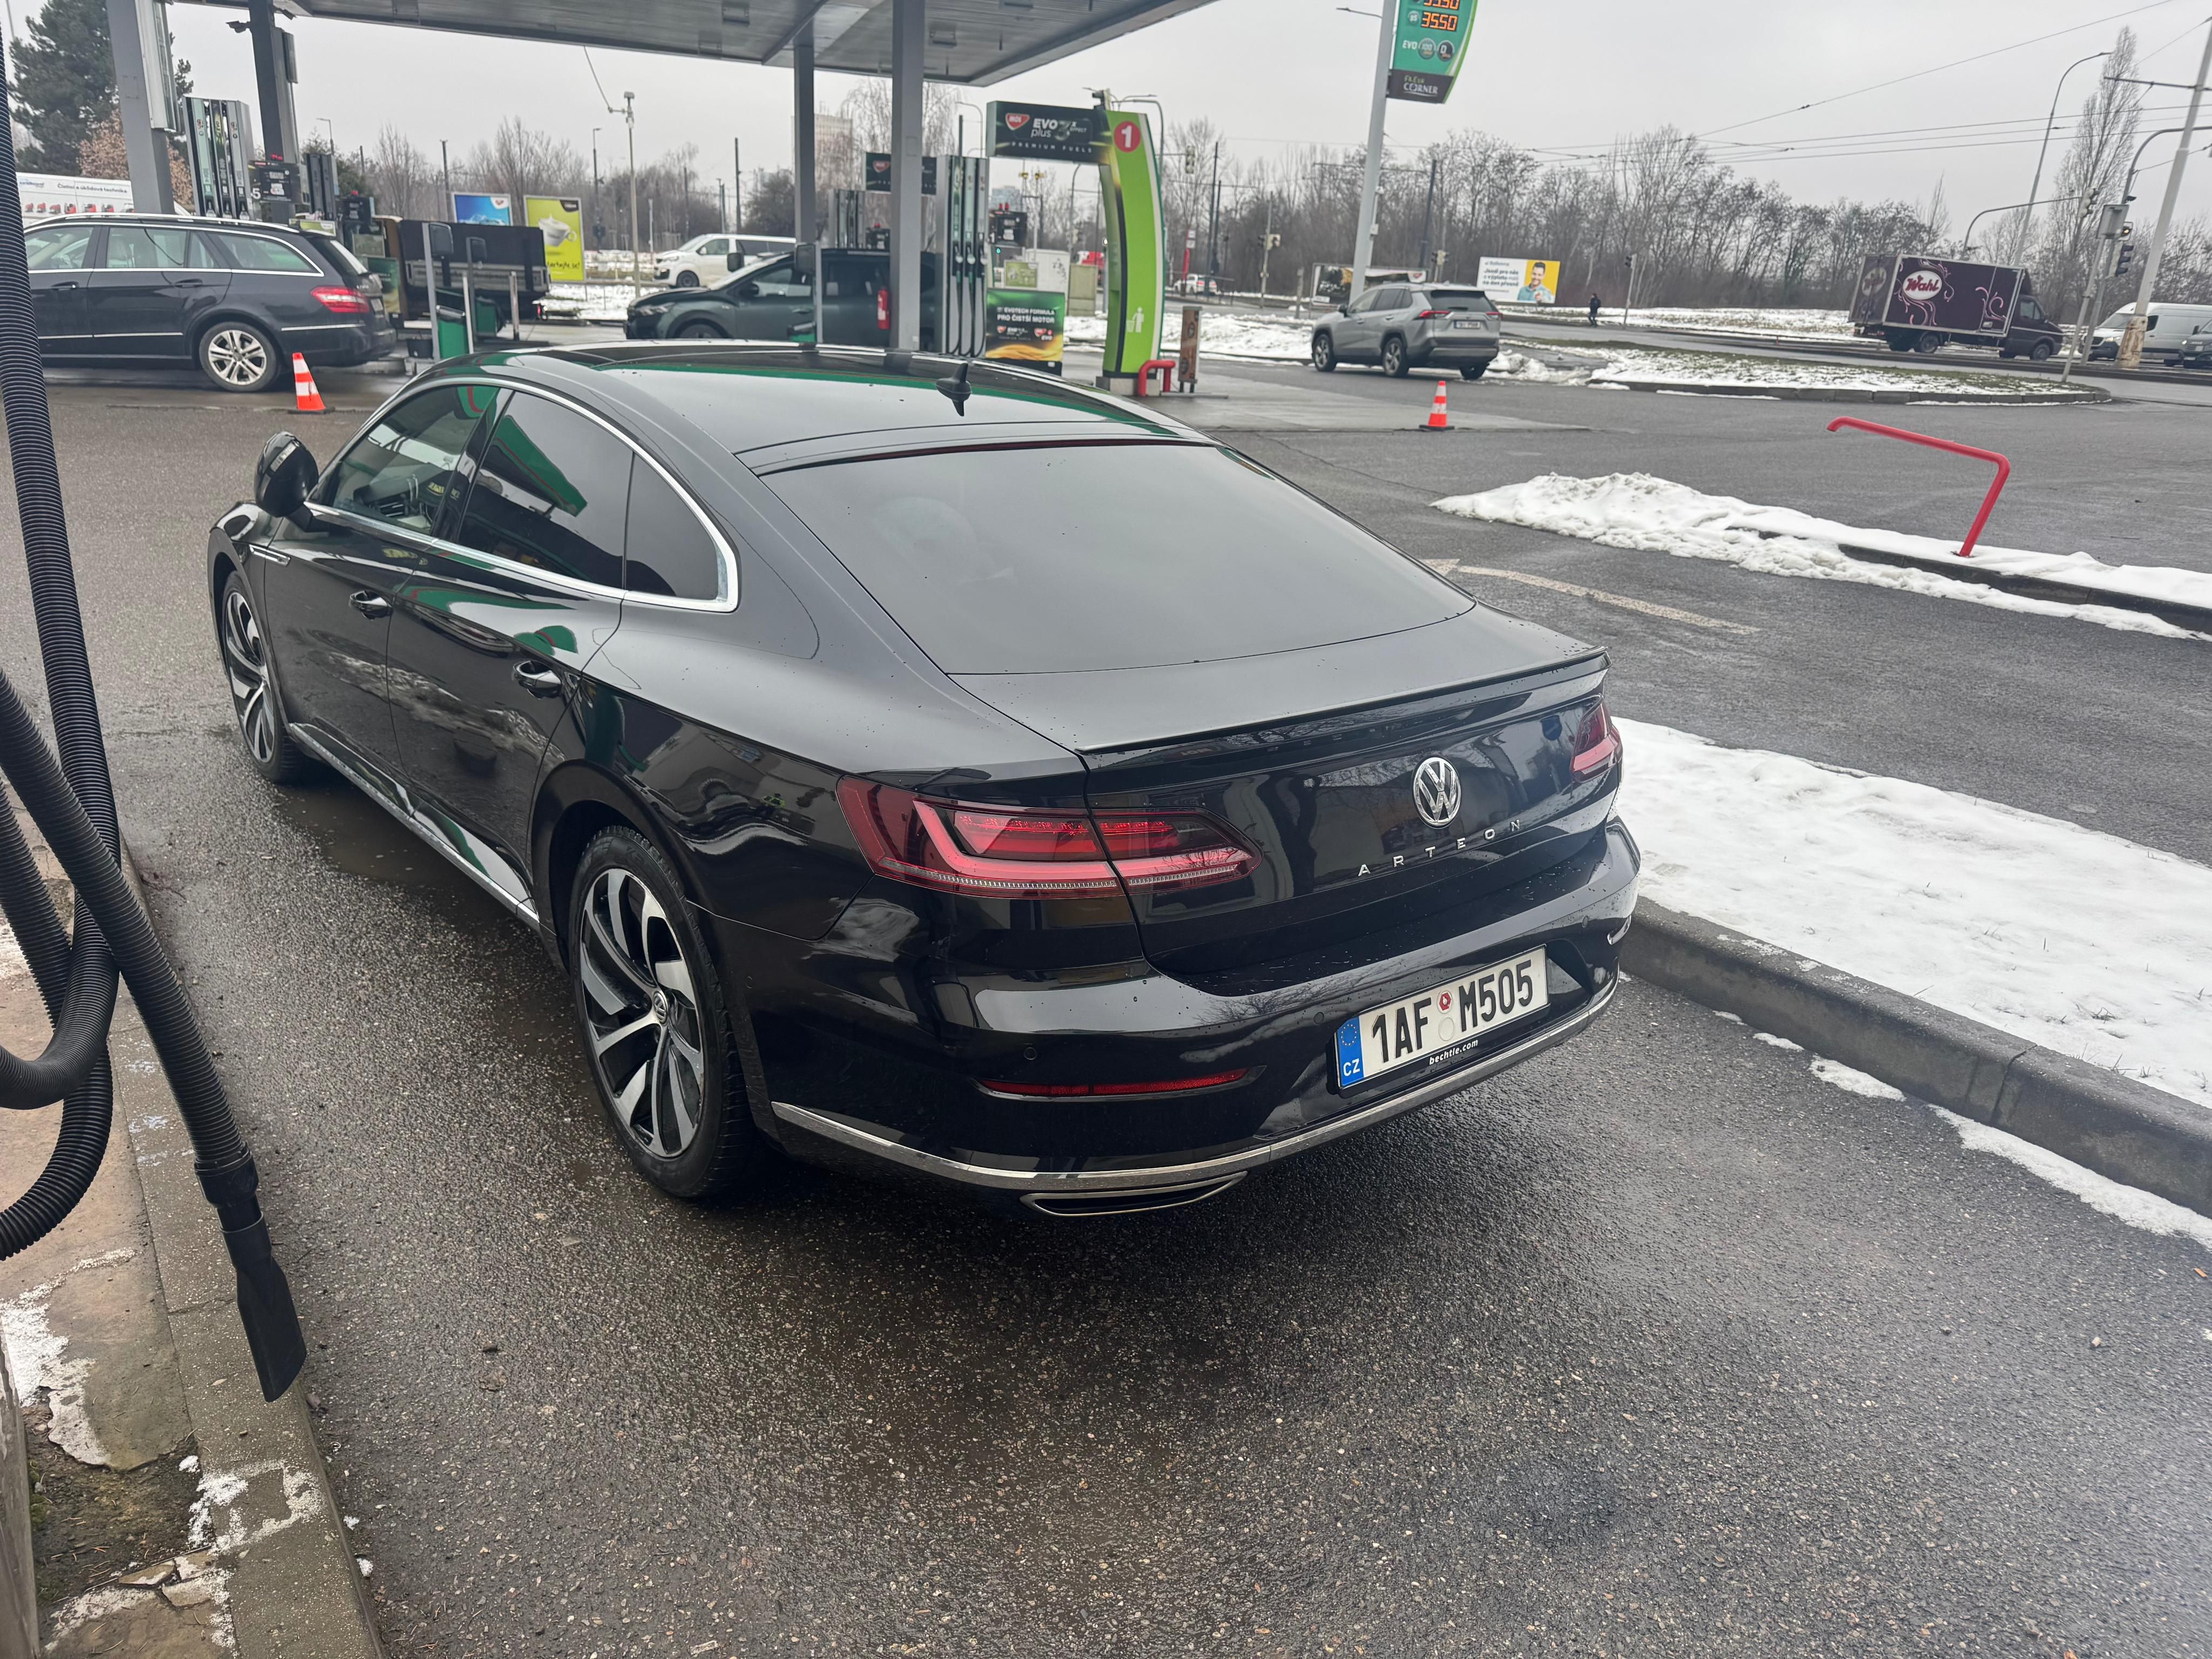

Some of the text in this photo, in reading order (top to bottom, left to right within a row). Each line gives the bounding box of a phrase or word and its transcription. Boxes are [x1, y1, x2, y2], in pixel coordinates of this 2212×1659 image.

[1421, 12, 1458, 31] 3550
[1402, 40, 1418, 50] EVO
[1403, 83, 1439, 95] CORNER
[1032, 118, 1058, 130] EVO
[1030, 129, 1052, 138] plus
[1121, 125, 1132, 149] 1
[1011, 141, 1092, 153] PREMIUM FUELS
[252, 187, 261, 199] 5
[1905, 274, 1940, 292] Wahl
[1358, 820, 1520, 876] ARTEON
[1372, 959, 1533, 1064] 1AF M505
[1429, 1039, 1479, 1065] bechtle.com
[1343, 1058, 1360, 1077] CZ
